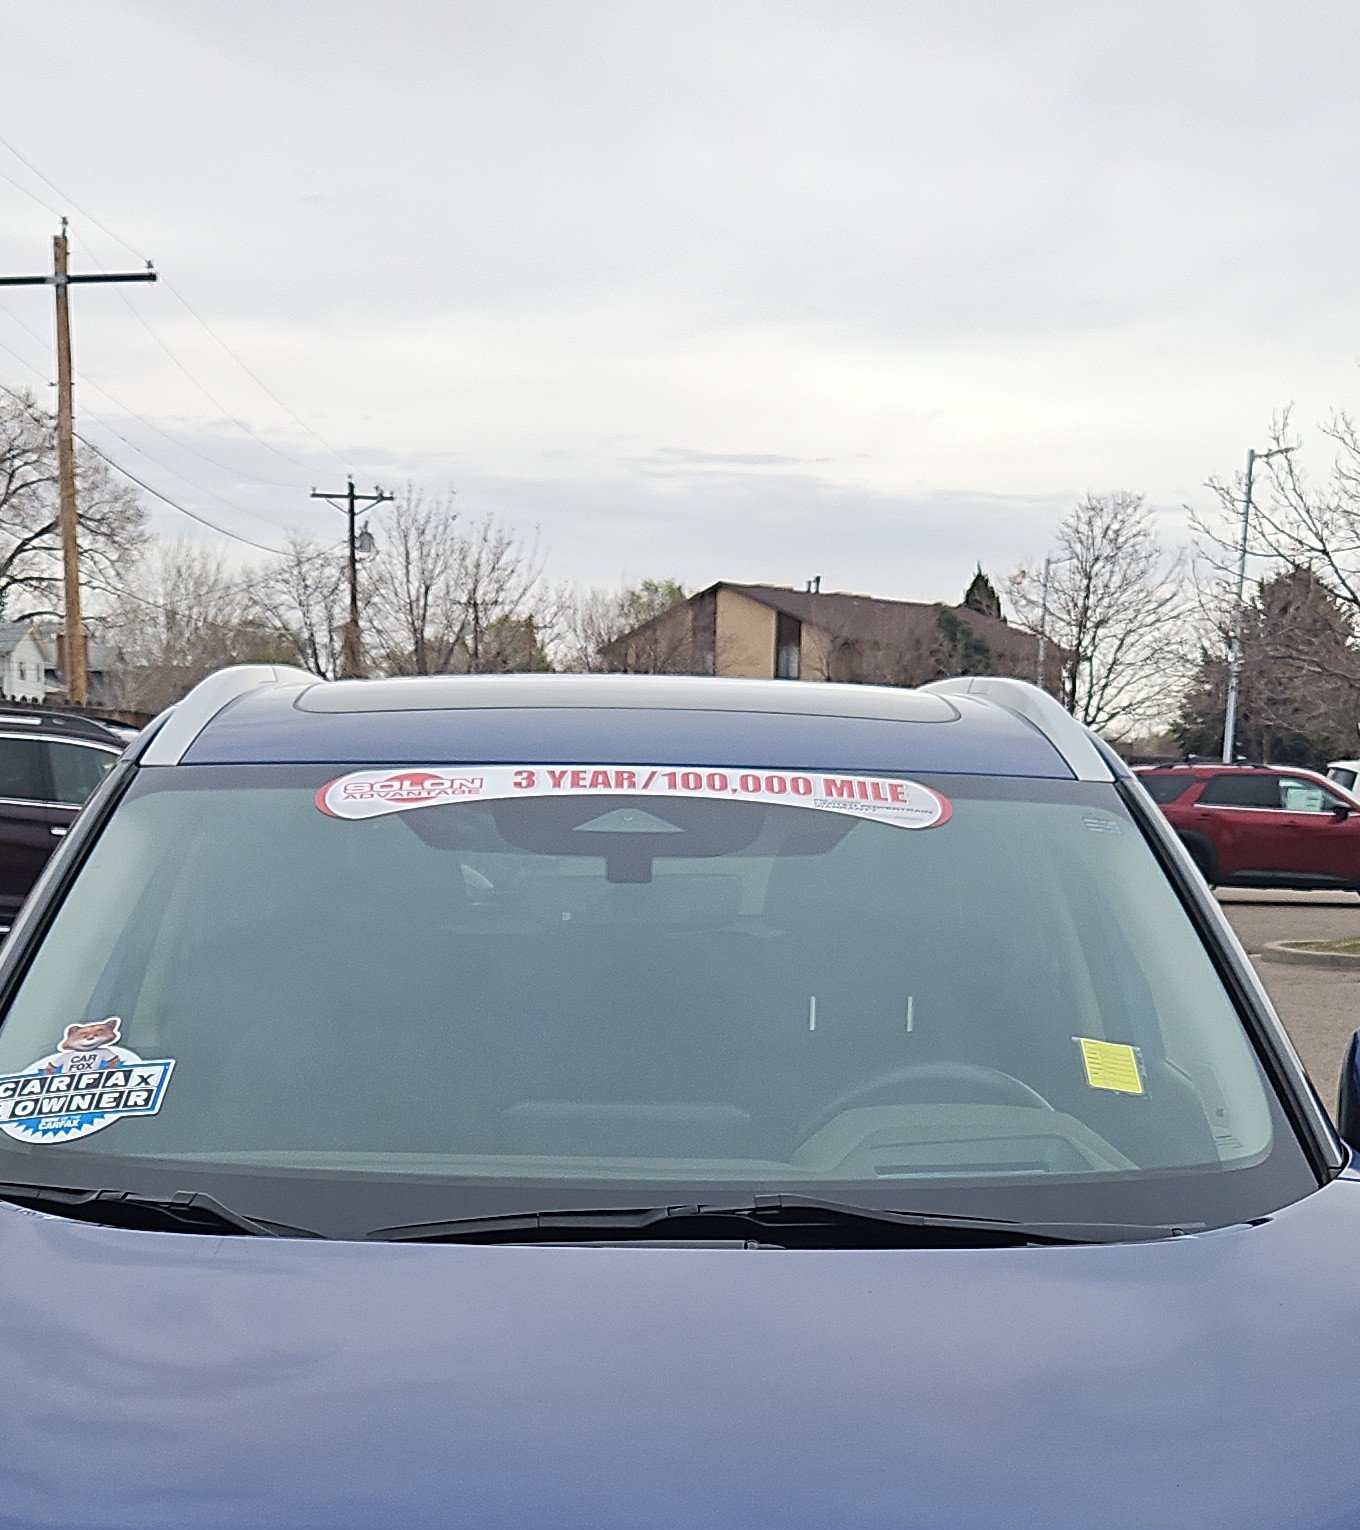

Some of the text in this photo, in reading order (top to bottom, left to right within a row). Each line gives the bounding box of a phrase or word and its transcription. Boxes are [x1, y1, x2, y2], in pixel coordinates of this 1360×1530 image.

[343, 777, 484, 795] SOLON
[512, 769, 908, 804] 3 YEAR/100,000 MILE
[343, 788, 481, 801] ADVANTAGE
[70, 1054, 97, 1064] CAR
[68, 1061, 94, 1072] FOX
